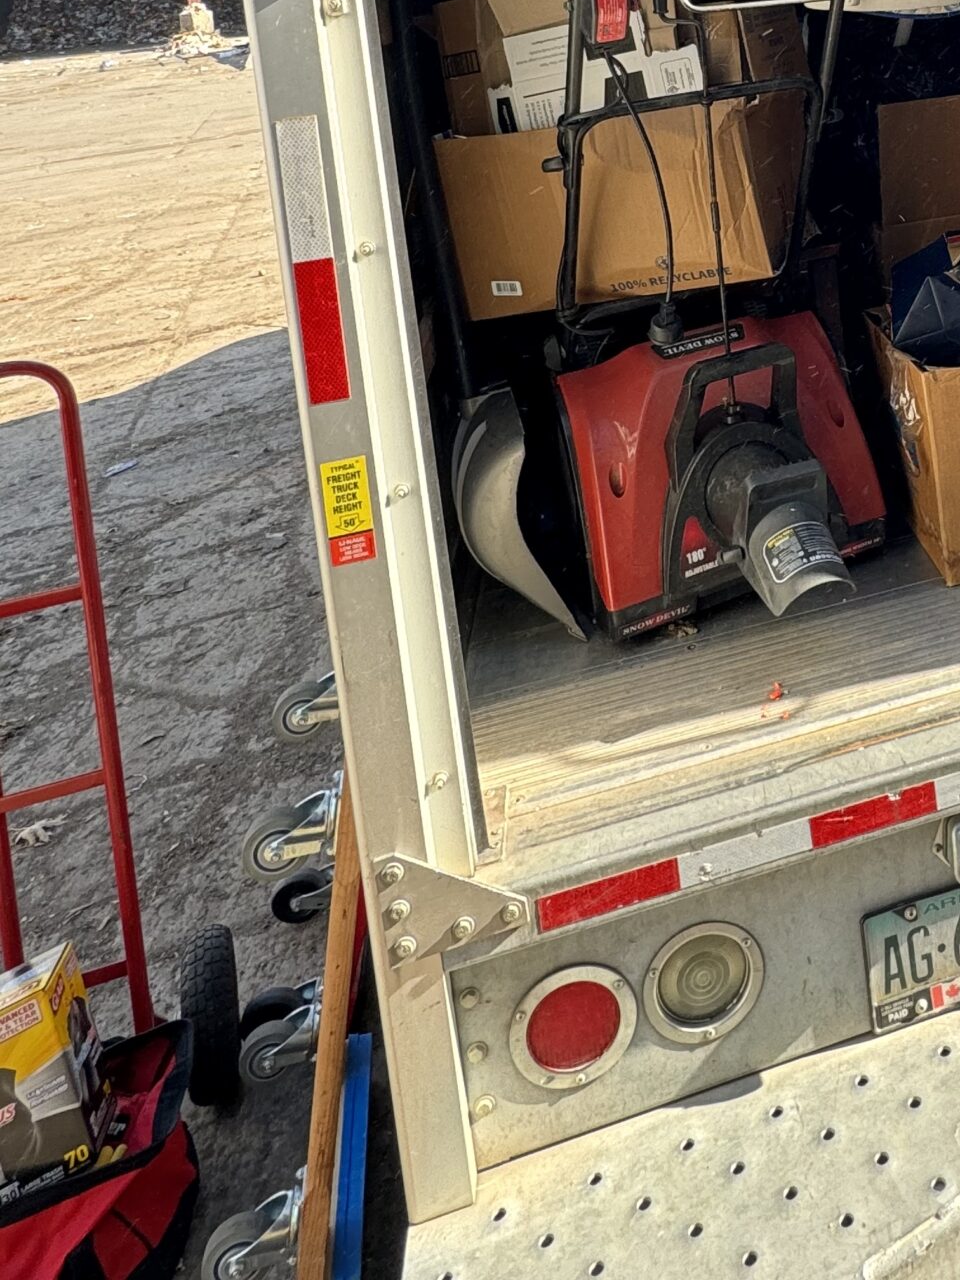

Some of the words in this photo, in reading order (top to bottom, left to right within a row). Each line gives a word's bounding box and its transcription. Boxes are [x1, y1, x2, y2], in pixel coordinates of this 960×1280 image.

[610, 279, 647, 293] 100%
[649, 267, 732, 286] REYCLABE
[330, 462, 355, 473] TYPICAL
[326, 470, 361, 485] FREIGHT
[331, 481, 359, 494] TRUCK
[335, 492, 358, 504] DECK
[333, 501, 362, 515] HEIGHT
[685, 560, 719, 578] ADJUSTABLE
[623, 618, 656, 636] SNOW
[656, 606, 688, 623] DEVIL
[13, 1009, 37, 1025] TEAR
[888, 1008, 909, 1023] PAID
[63, 1144, 89, 1169] 70
